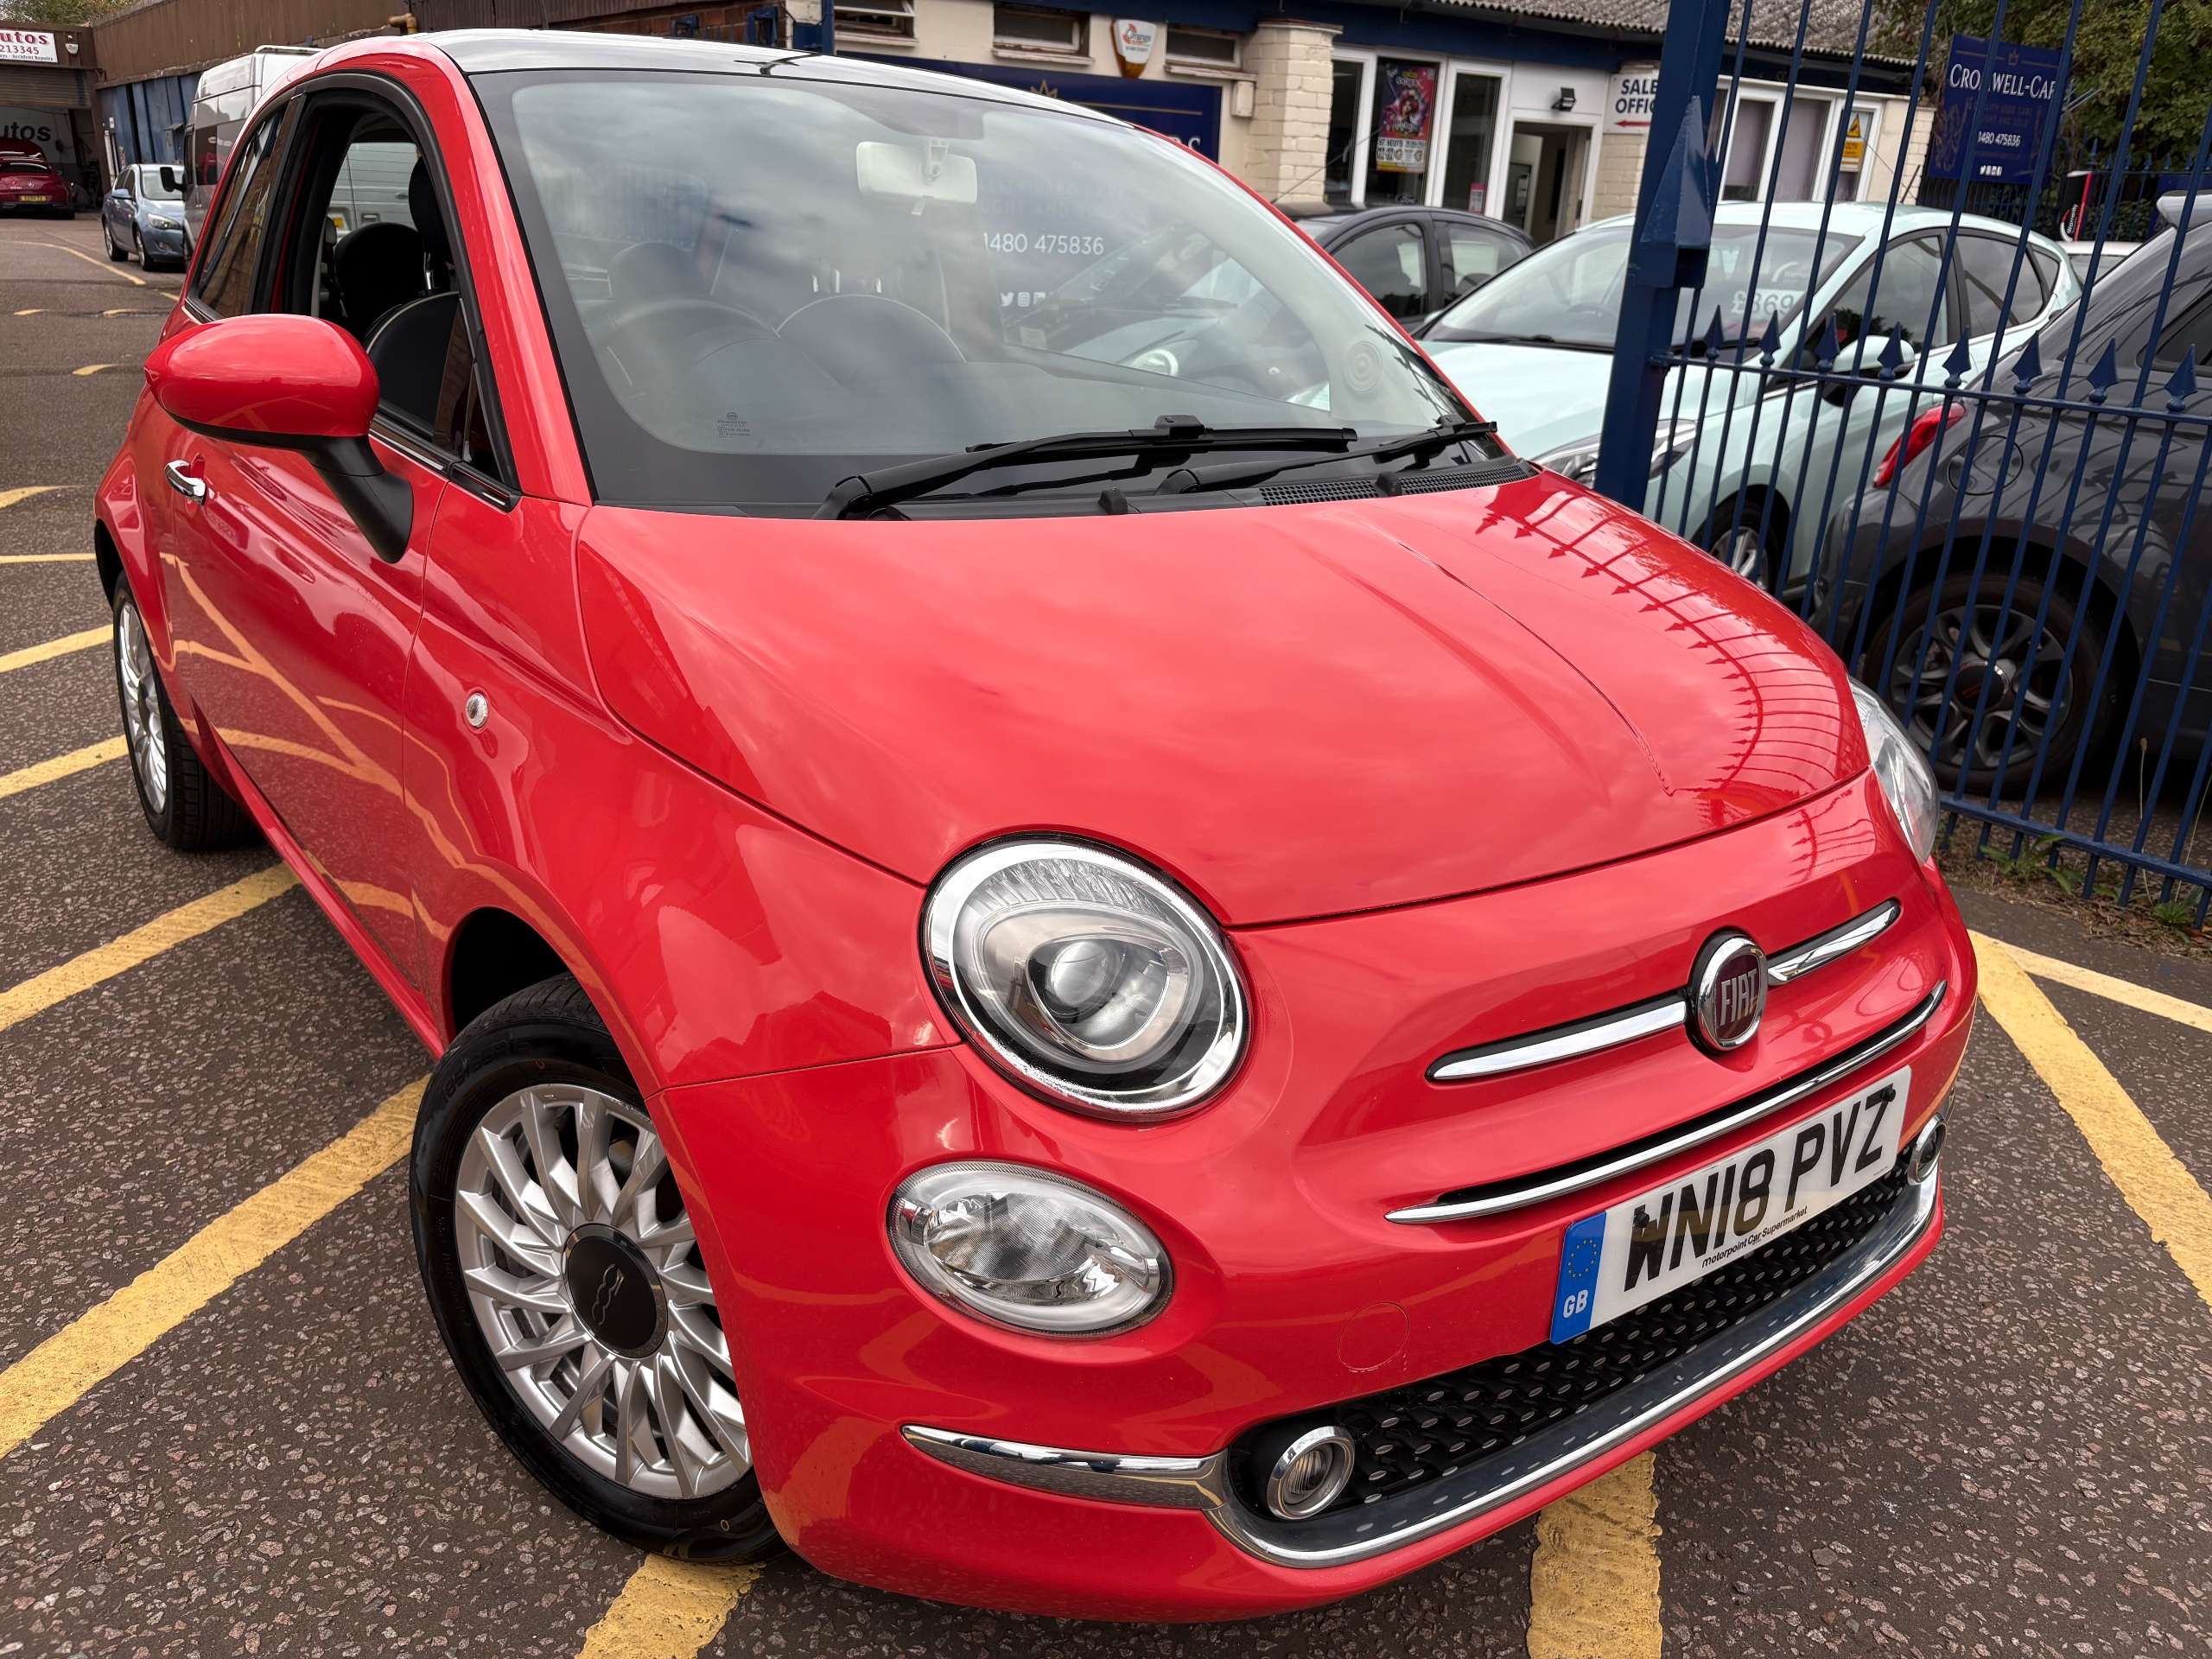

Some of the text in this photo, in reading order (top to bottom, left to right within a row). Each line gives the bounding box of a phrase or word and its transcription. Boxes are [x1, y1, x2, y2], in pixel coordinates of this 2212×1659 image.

[1034, 235, 1105, 255] 475836
[1719, 968, 1758, 1027] FIAT
[1624, 1083, 1895, 1292] WN18 PVZ
[1747, 1233, 1763, 1245] Car
[1762, 1205, 1808, 1237] Supermarket
[1562, 1288, 1589, 1319] GB
